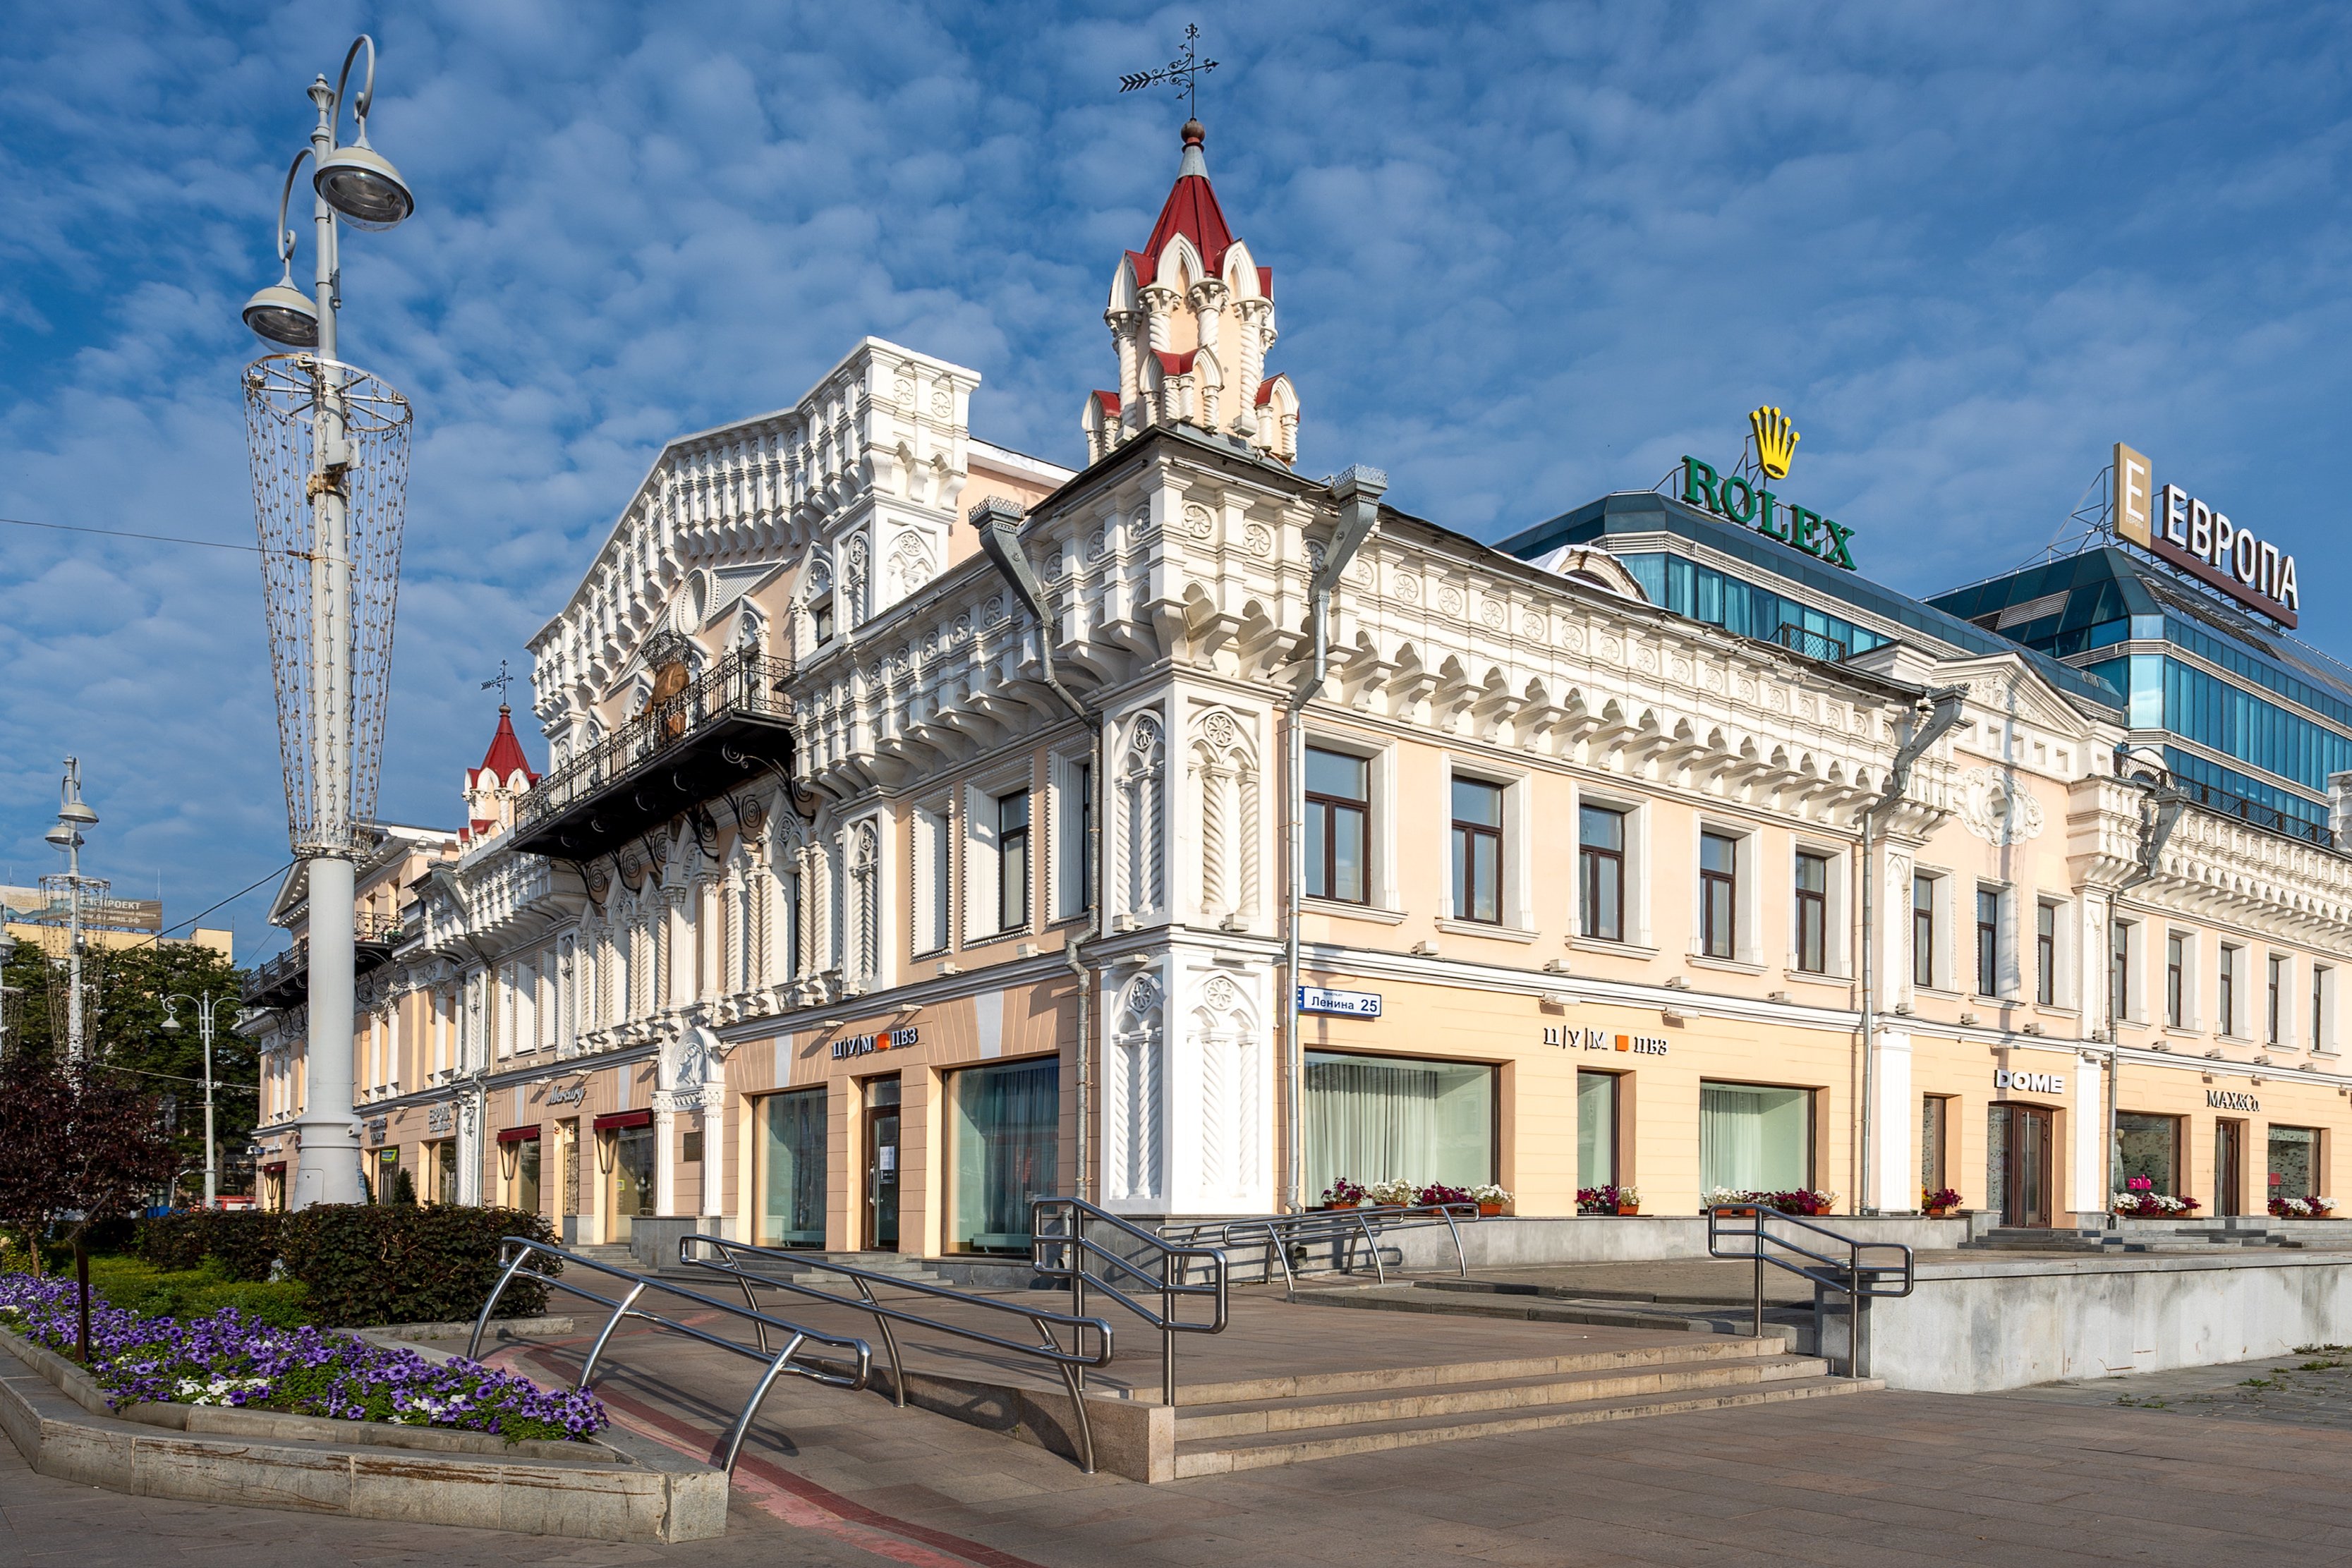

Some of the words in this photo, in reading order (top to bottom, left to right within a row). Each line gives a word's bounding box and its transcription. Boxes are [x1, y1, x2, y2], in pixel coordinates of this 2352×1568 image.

[1681, 455, 1857, 571] ROLEX
[2162, 483, 2300, 611] ЕВРОПА
[1311, 996, 1354, 1010] Ленина
[1360, 999, 1378, 1013] 25
[891, 1028, 919, 1047] ПВЗ
[1633, 1036, 1670, 1056] ПВЗ
[1994, 1069, 2066, 1094] DOME
[2128, 1174, 2152, 1191] sale
